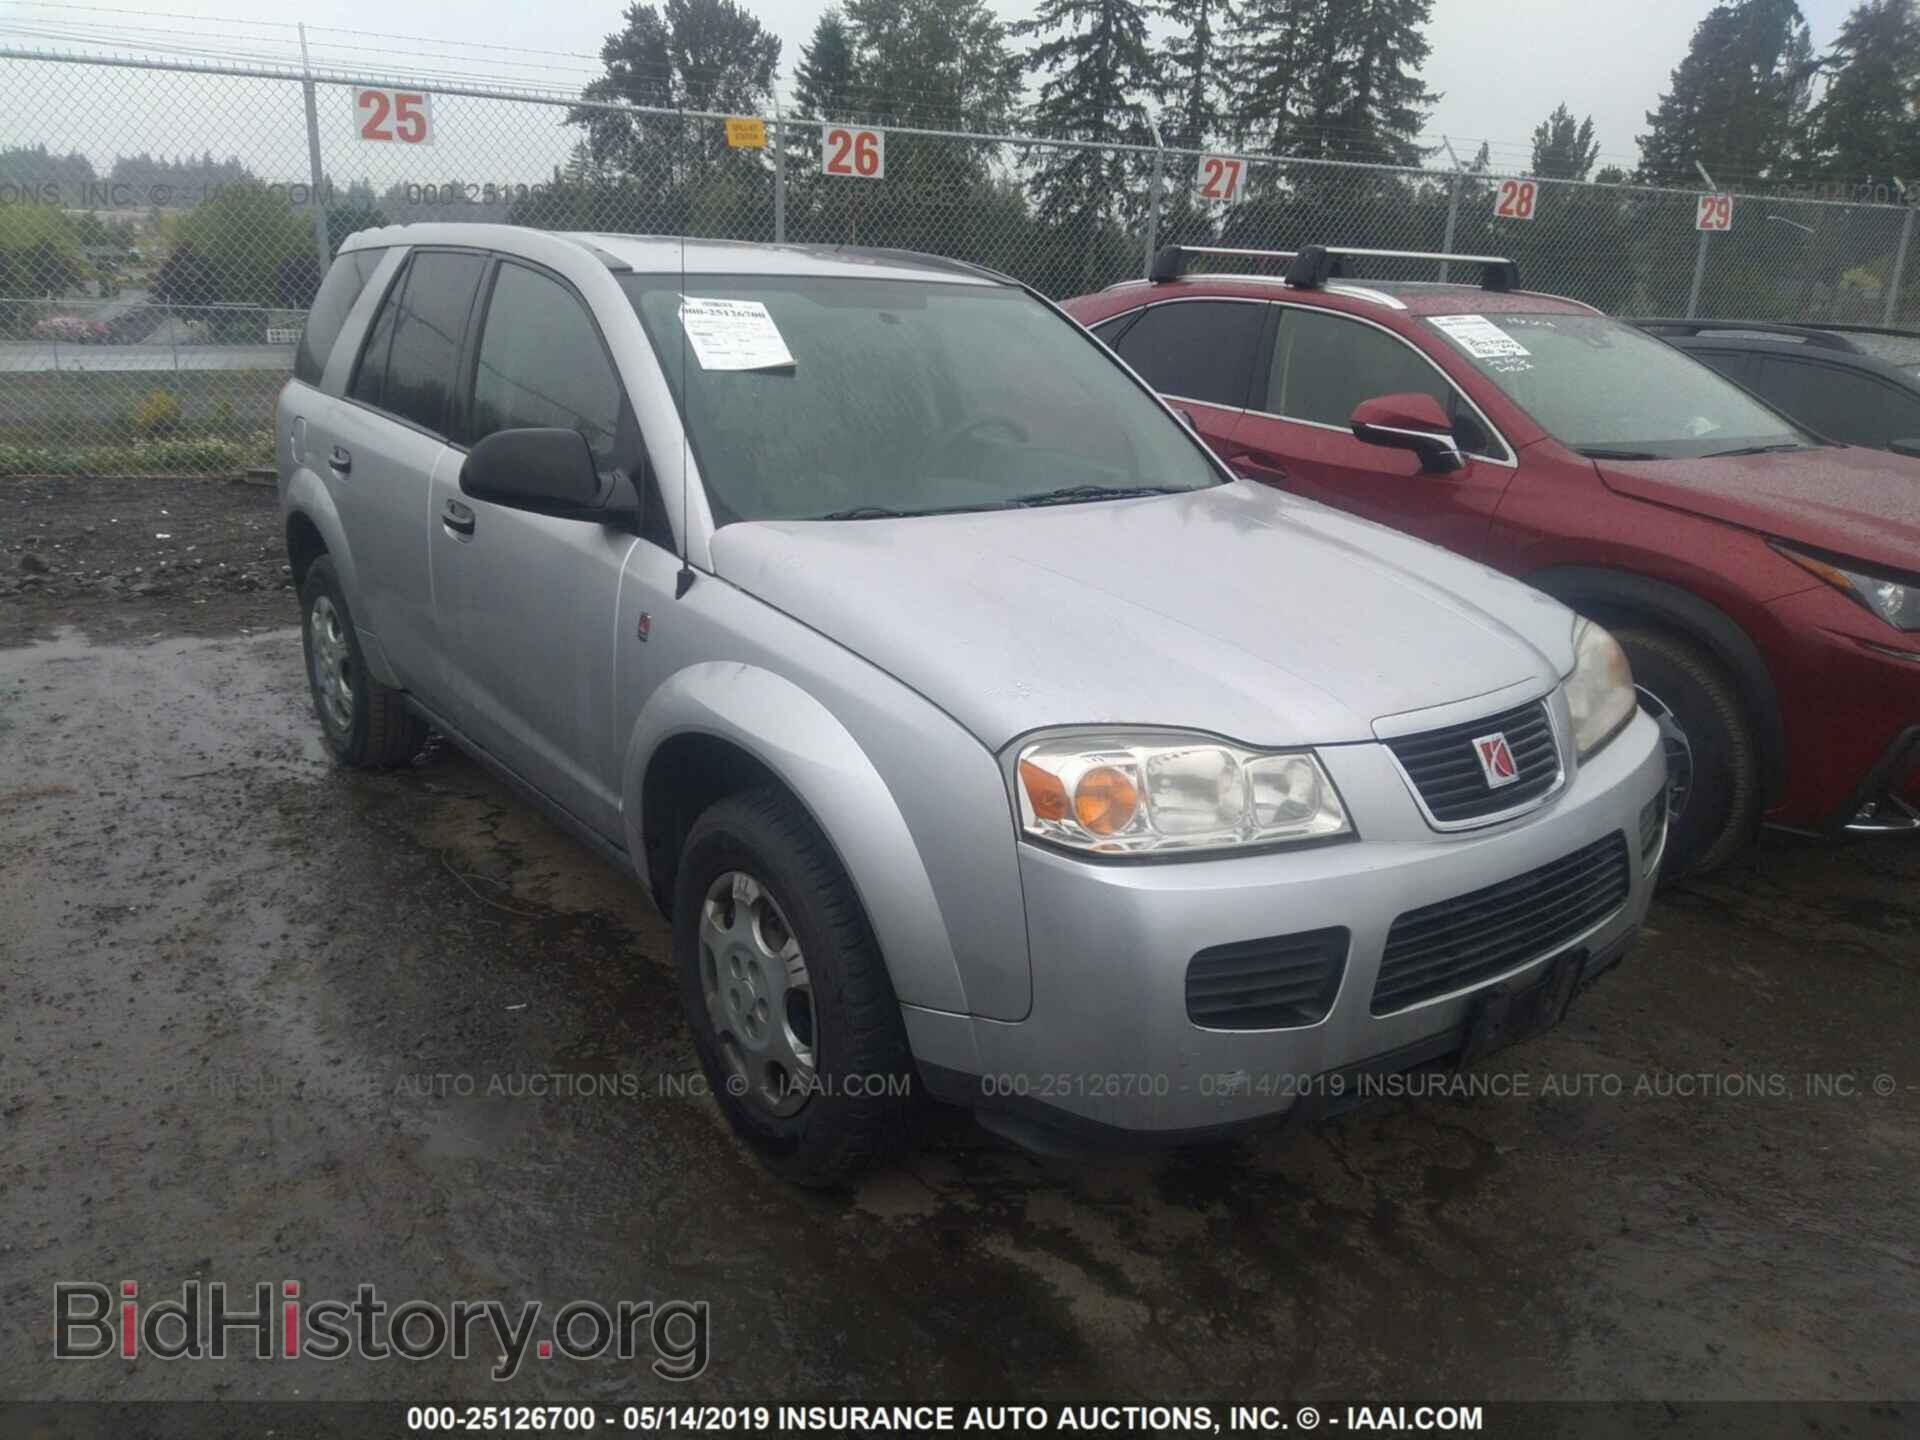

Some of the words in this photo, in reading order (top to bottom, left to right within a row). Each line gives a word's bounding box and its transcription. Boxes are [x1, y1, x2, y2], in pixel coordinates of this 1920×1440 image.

[358, 90, 427, 143] 25
[827, 128, 879, 176] 26
[1201, 158, 1241, 199] 27
[1498, 180, 1535, 217] 28
[1700, 197, 1731, 230] 29
